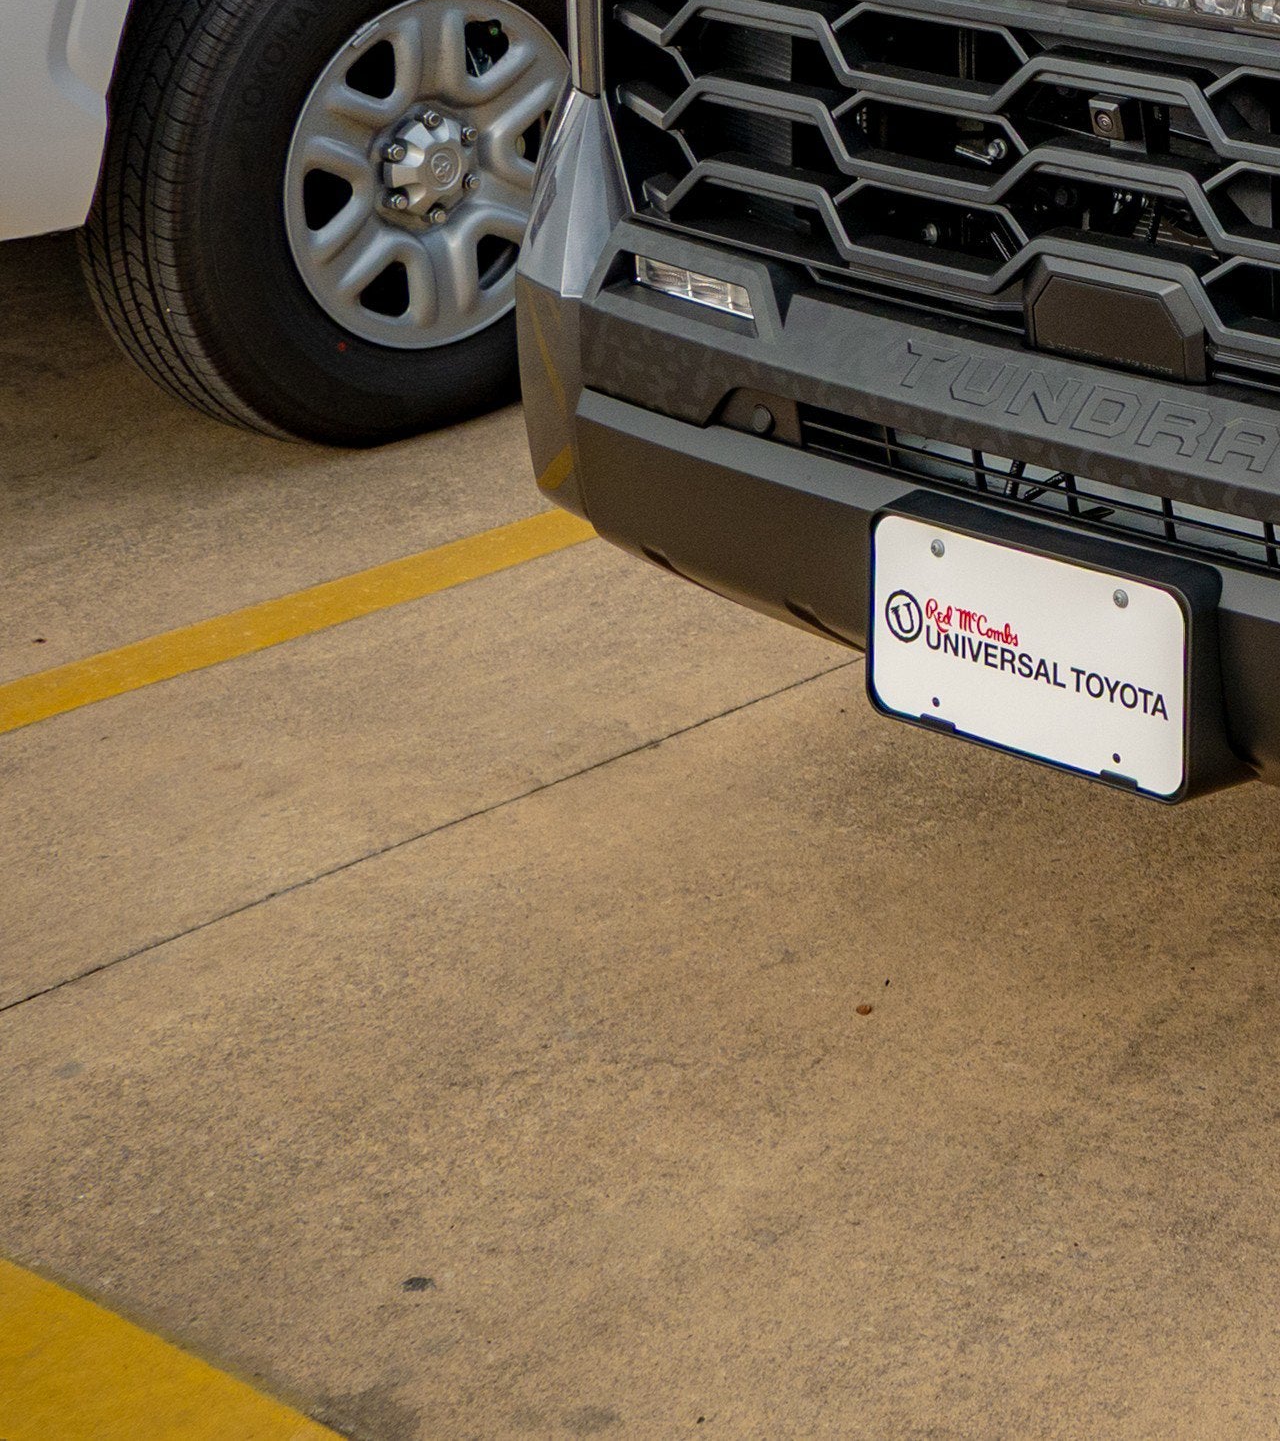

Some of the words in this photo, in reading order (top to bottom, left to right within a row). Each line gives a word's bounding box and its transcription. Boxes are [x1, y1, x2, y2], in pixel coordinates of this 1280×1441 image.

[925, 598, 953, 633] Red
[955, 606, 1019, 647] McCombs
[925, 624, 1066, 690] UNIVERSAL
[1071, 666, 1169, 722] TOYOTA
